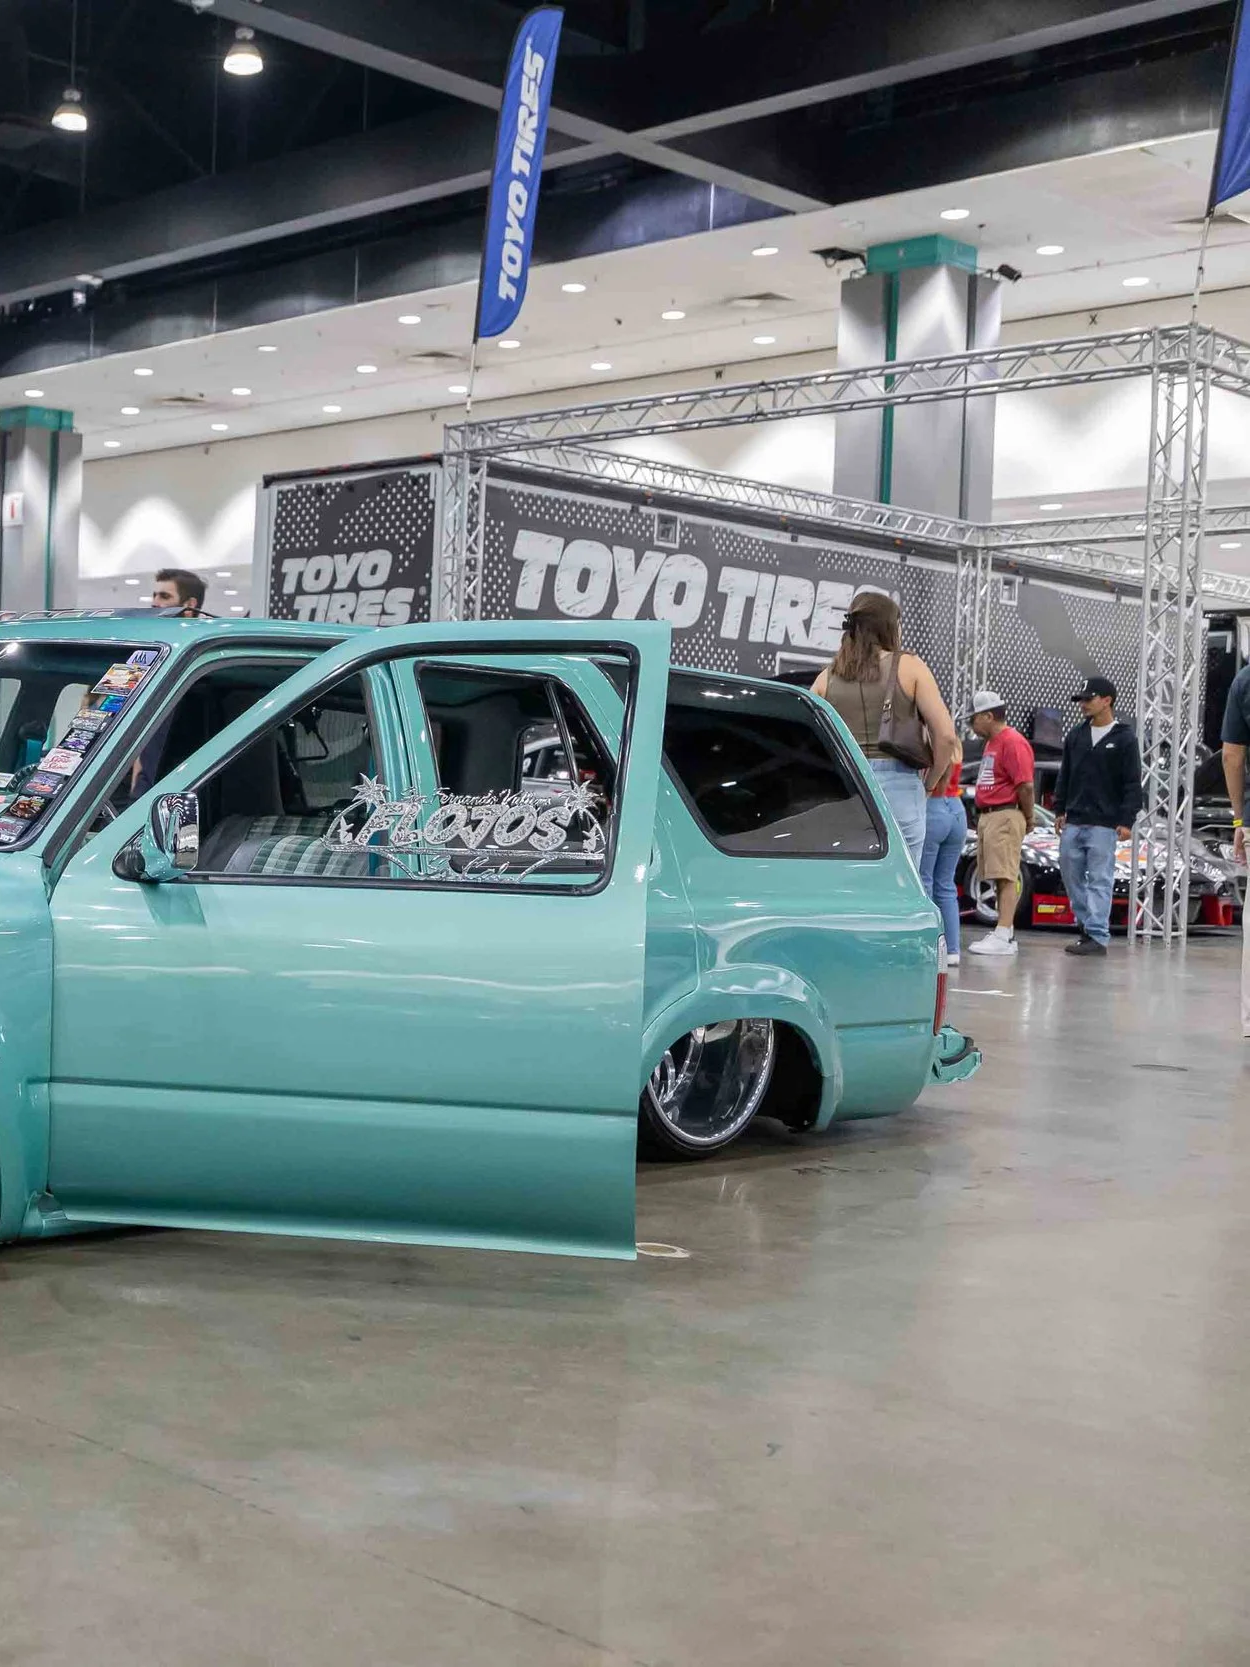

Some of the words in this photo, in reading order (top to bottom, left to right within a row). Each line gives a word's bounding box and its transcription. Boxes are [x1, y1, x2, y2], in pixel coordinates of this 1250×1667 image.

[511, 47, 545, 178] TIRES
[498, 180, 528, 302] TOYO
[281, 549, 392, 595] TOYO
[294, 587, 415, 627] TIRES
[512, 529, 708, 629] TOYO
[717, 566, 890, 652] TIRE
[355, 800, 573, 851] FLOJOS
